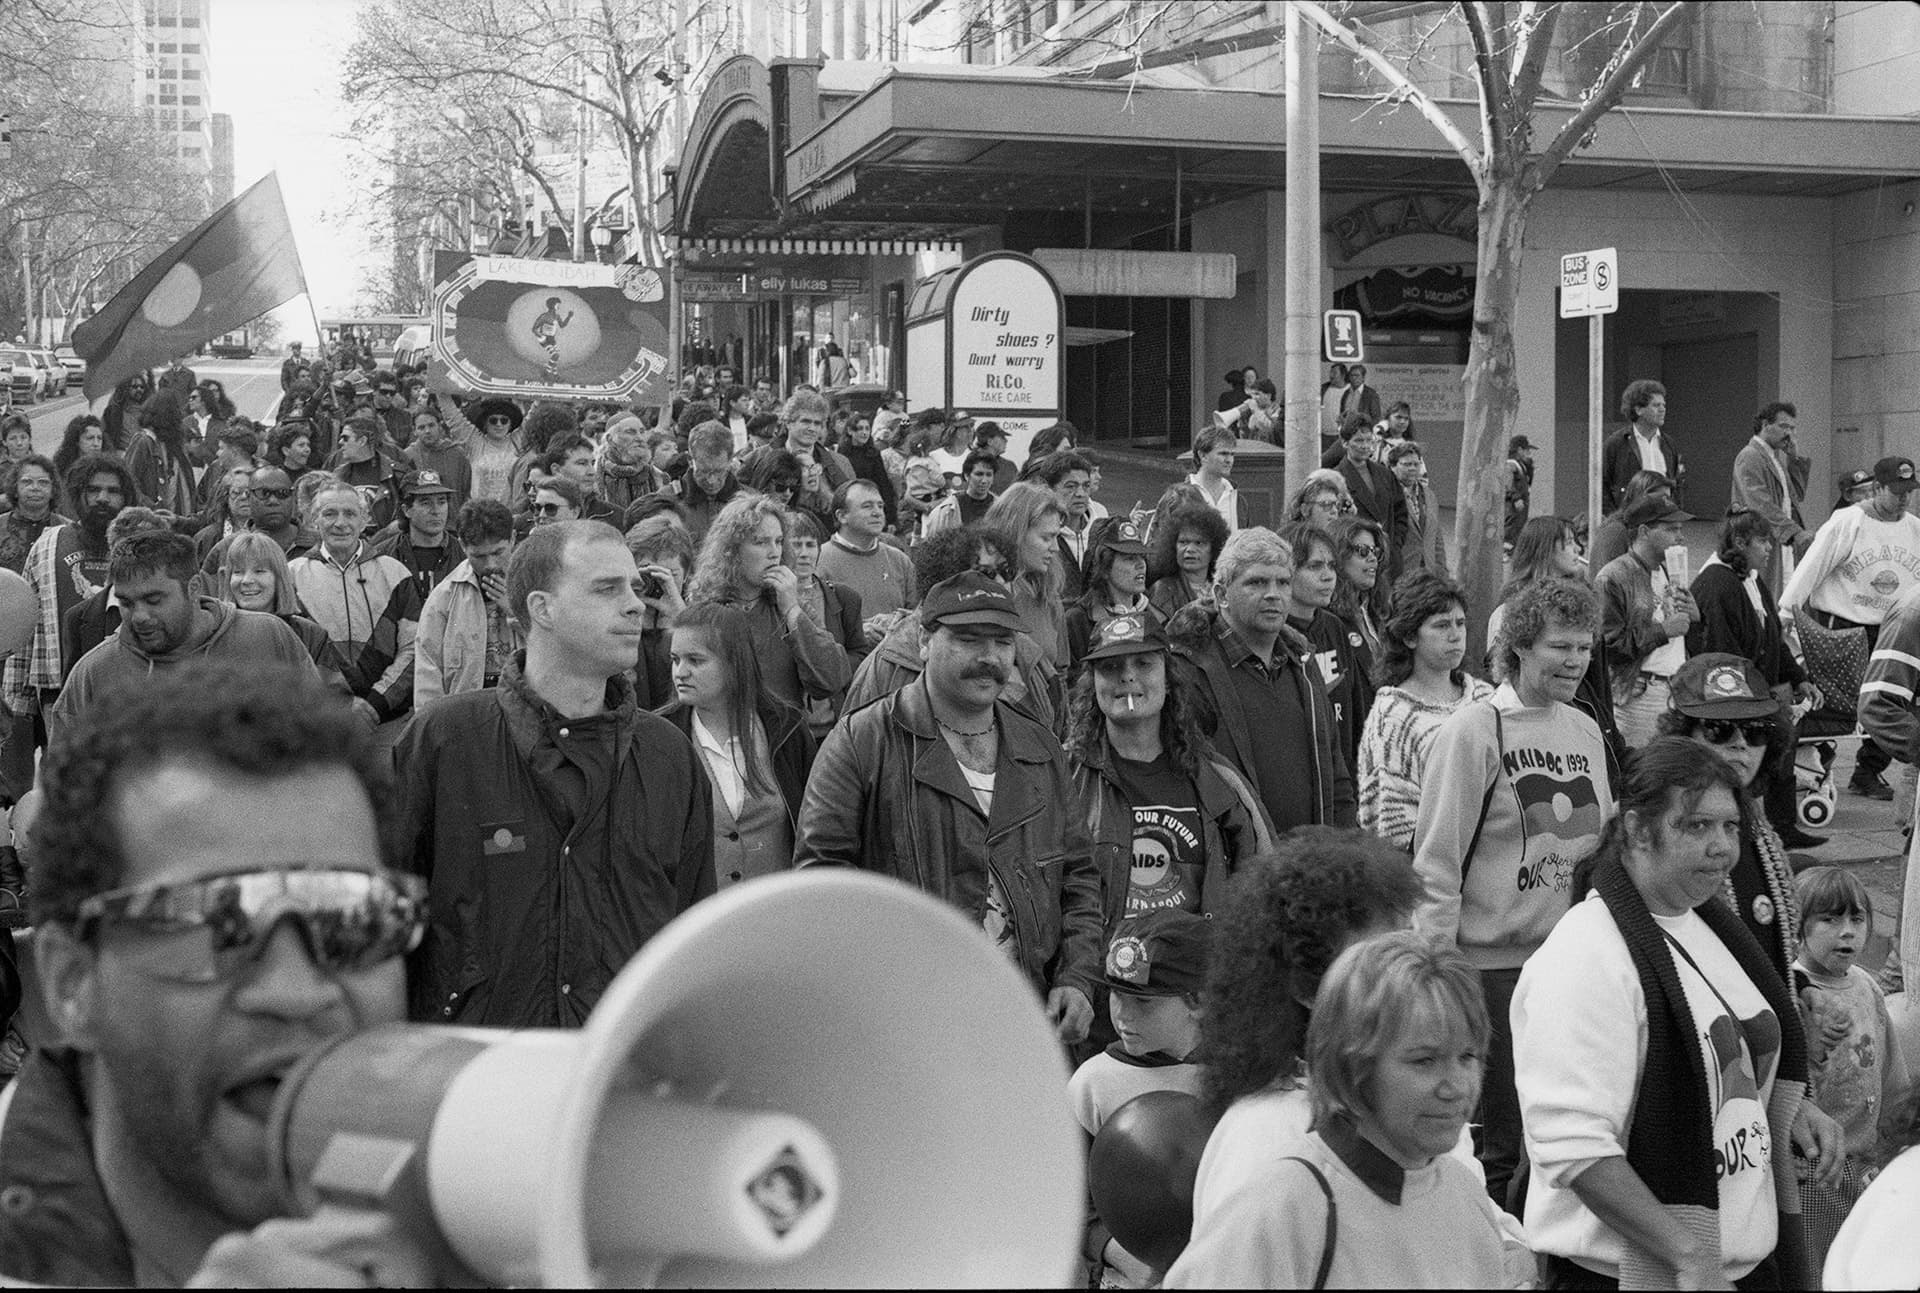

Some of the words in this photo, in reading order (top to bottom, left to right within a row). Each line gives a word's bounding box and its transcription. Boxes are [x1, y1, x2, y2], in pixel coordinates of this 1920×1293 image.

[1328, 187, 1478, 264] PLAZ
[1565, 257, 1585, 272] BUS
[761, 277, 785, 291] elly
[790, 278, 828, 290] lukas
[1564, 272, 1587, 286] ZONE
[1402, 287, 1420, 298] NO
[1424, 286, 1469, 303] VACANCY
[970, 306, 1010, 326] Dirty
[996, 332, 1039, 347] shoes
[1006, 356, 1044, 370] worry
[980, 391, 1003, 403] TAKE
[1006, 392, 1032, 404] CARE
[1566, 754, 1590, 774] 1992
[1134, 811, 1159, 824] OUR
[1162, 814, 1199, 848] FUTURE
[1517, 856, 1552, 891] OUR
